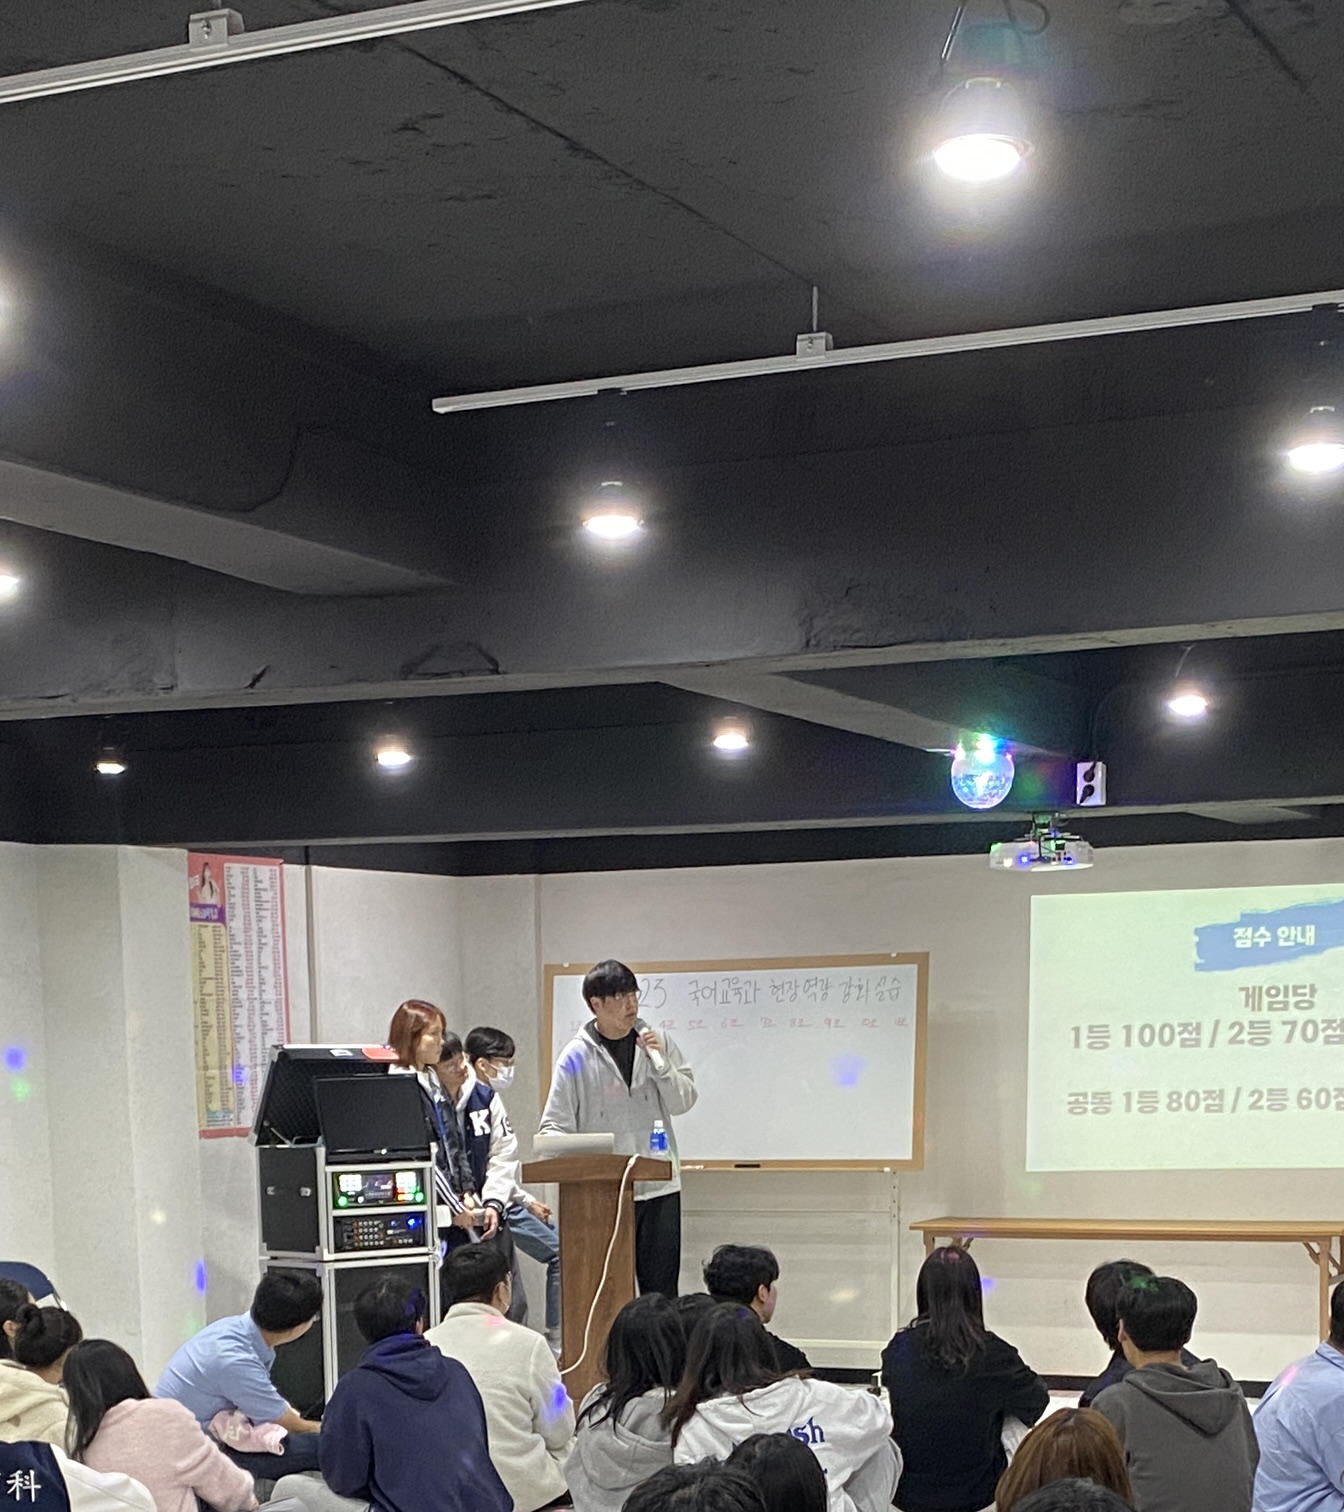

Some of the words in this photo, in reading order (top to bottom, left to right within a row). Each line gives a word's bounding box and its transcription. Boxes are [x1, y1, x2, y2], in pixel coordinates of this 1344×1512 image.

[1233, 926, 1272, 948] 점수
[1276, 924, 1316, 947] 안내
[1238, 983, 1318, 1012] 게임당
[1071, 1023, 1111, 1050] 1등
[1122, 1021, 1202, 1049] 100점
[1208, 1019, 1221, 1048] /
[1228, 1019, 1272, 1047] 2등
[1067, 1090, 1113, 1115] 공동
[1123, 1089, 1160, 1114] 1등
[1166, 1088, 1225, 1113] 80점
[1230, 1086, 1242, 1114] /
[1247, 1088, 1289, 1112] 2등
[468, 1108, 491, 1137] K
